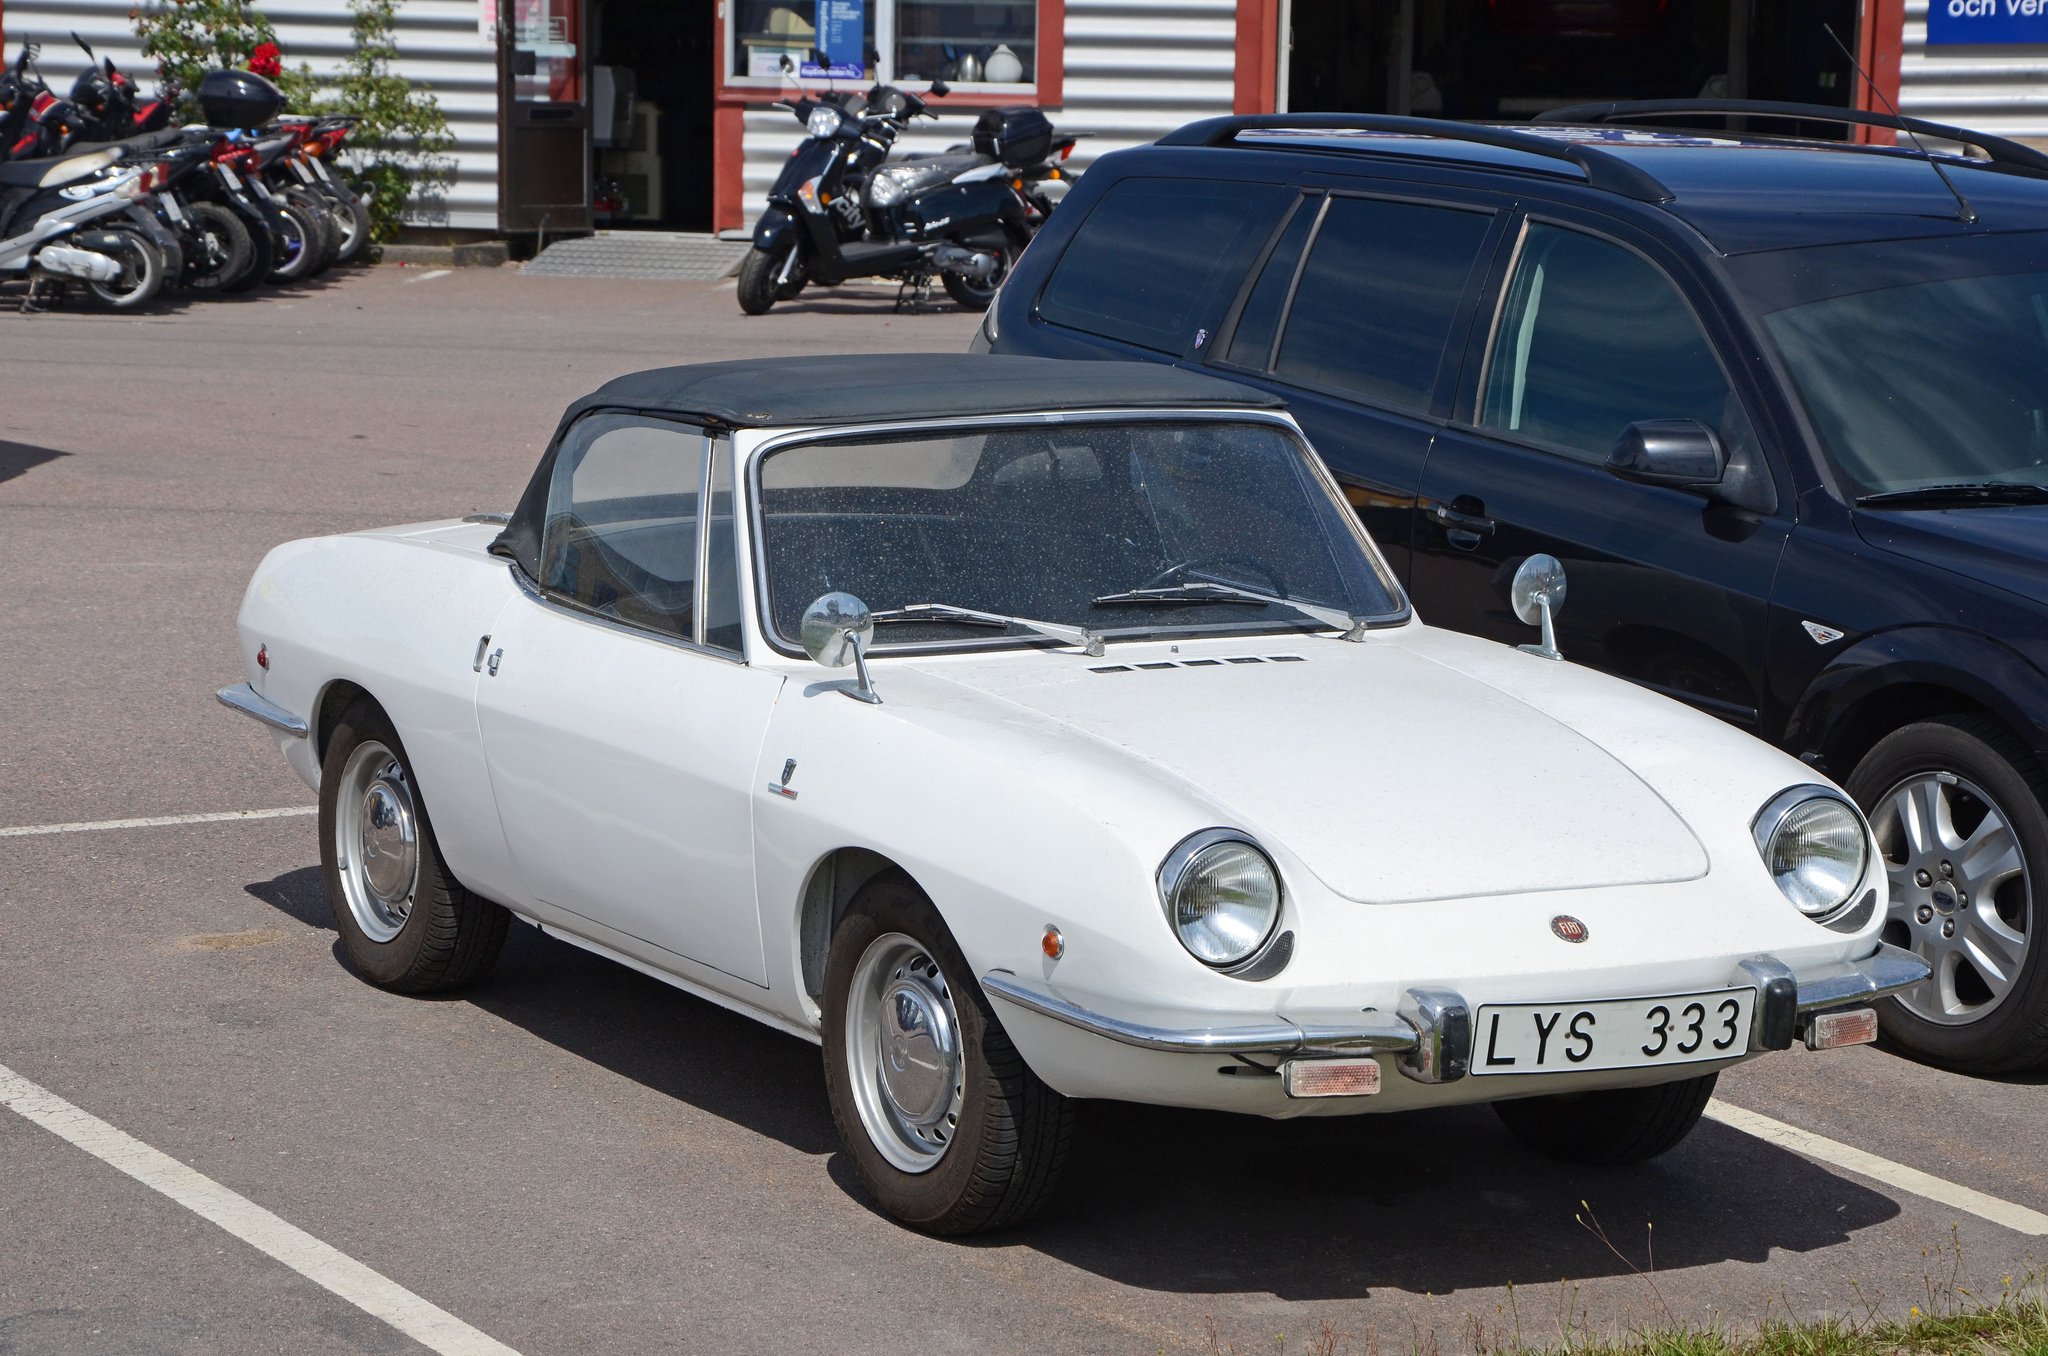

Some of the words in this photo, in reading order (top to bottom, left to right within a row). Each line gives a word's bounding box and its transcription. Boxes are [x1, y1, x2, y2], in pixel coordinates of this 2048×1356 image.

[1948, 0, 1996, 17] och
[1558, 921, 1582, 935] FIAT
[1486, 1011, 1596, 1066] LYS
[1641, 999, 1740, 1057] 333
